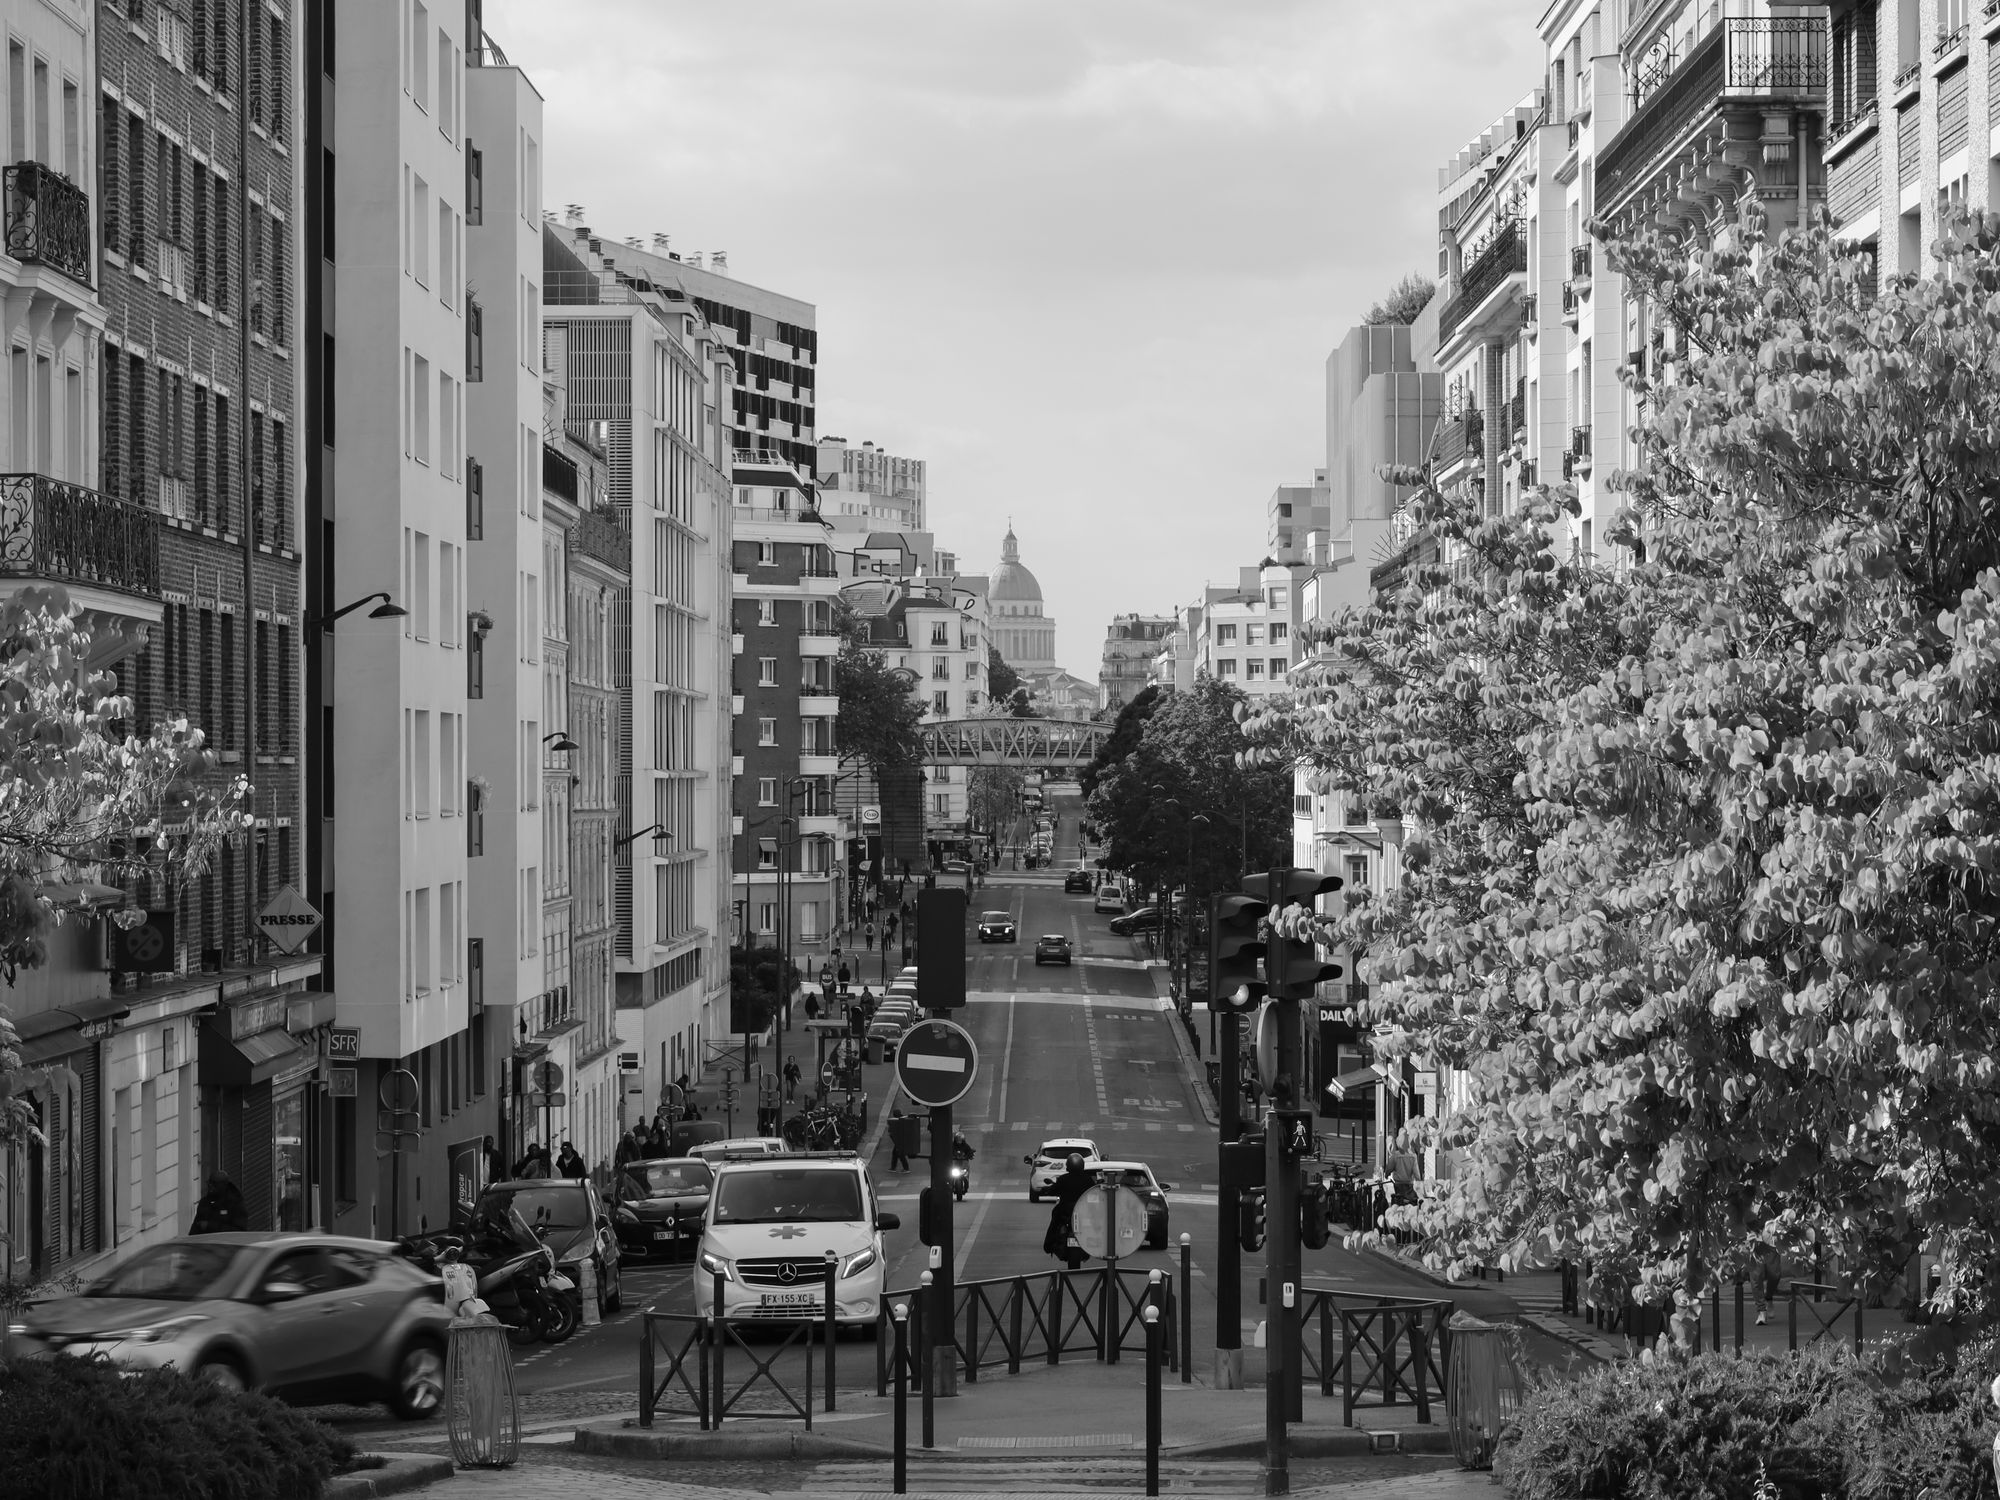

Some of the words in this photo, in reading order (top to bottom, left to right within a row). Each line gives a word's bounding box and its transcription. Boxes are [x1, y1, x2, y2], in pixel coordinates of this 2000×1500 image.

[260, 914, 315, 926] PRESSE
[1320, 1010, 1347, 1021] DAILY
[331, 1034, 356, 1051] SFR
[1123, 1097, 1183, 1108] BUS
[767, 1294, 808, 1303] FX-155-XC
